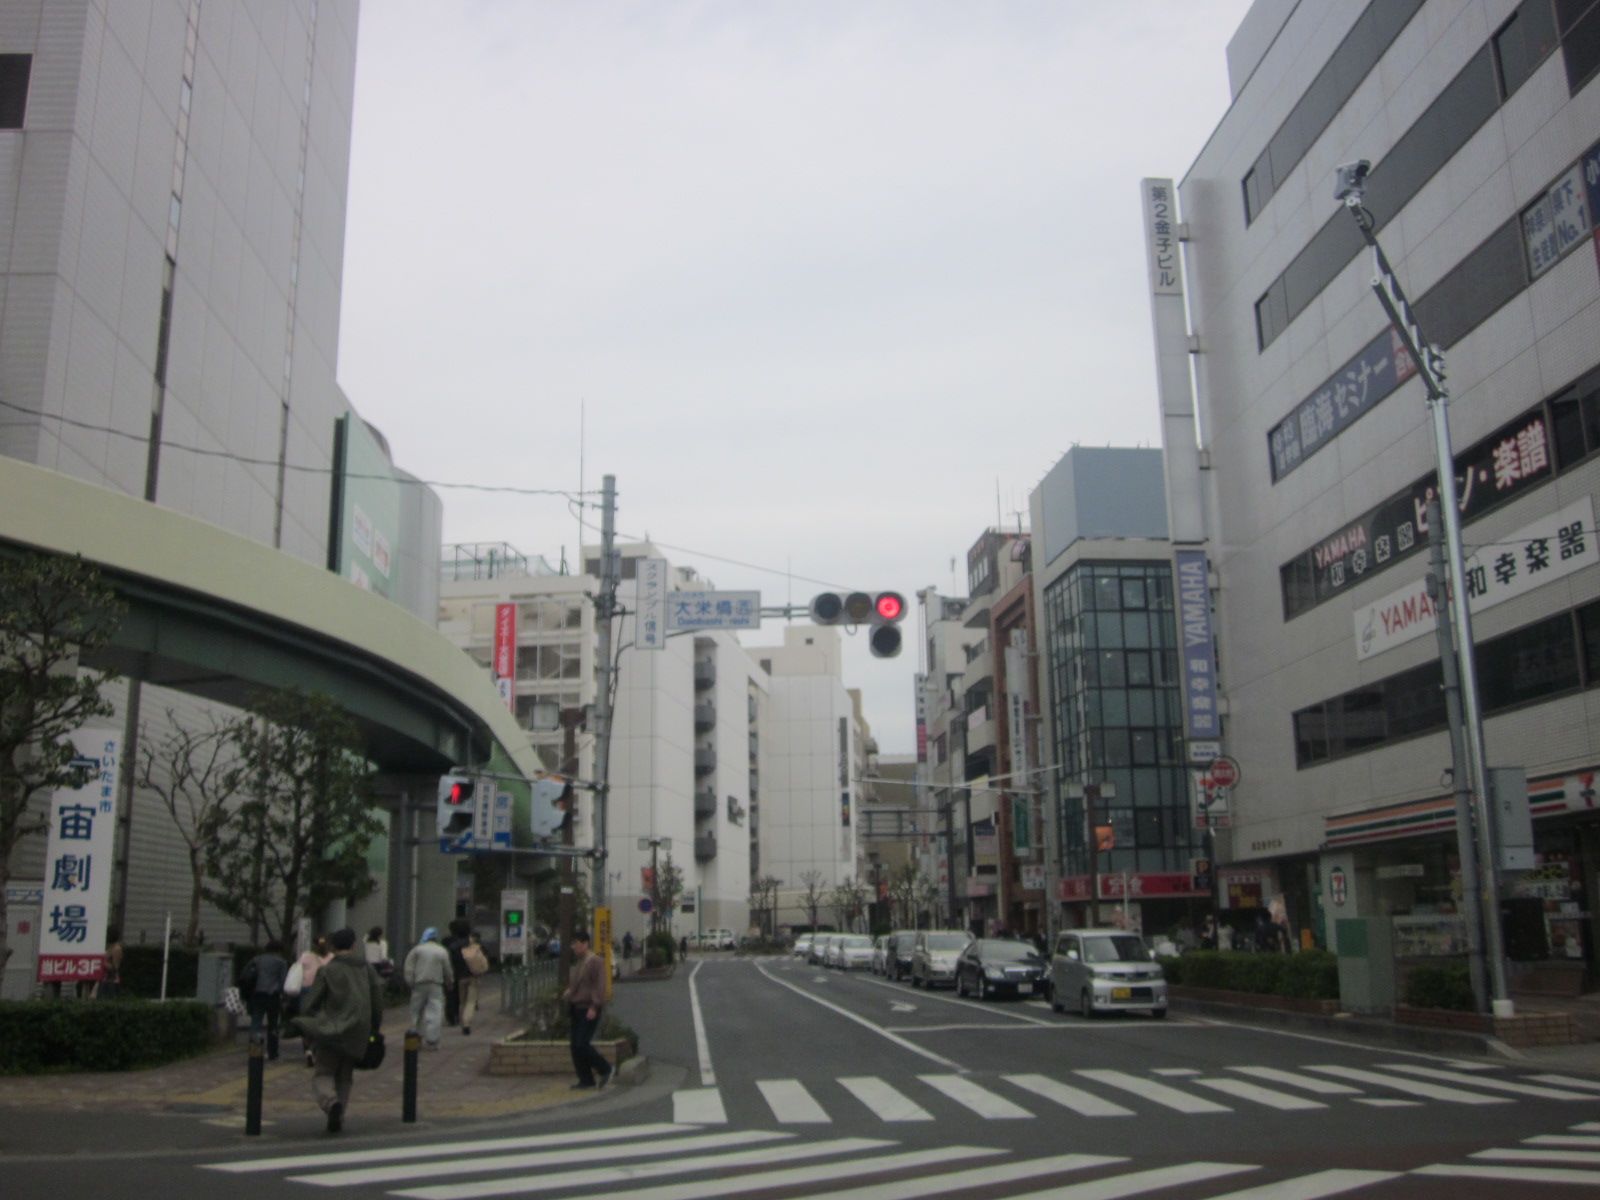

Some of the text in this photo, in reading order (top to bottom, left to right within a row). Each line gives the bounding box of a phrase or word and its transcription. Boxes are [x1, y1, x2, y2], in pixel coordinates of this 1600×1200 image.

[1151, 186, 1176, 286] 第2金子ビル
[1299, 357, 1389, 448] 臨海セミナー
[1414, 420, 1548, 534] ピノ・楽譜
[1315, 525, 1366, 568] YAMAHA
[1380, 520, 1586, 636] YAMA 和幸楽器
[1179, 561, 1208, 647] YAMAHA
[100, 740, 116, 812] さいたま市
[41, 961, 104, 977] 当ビル3F
